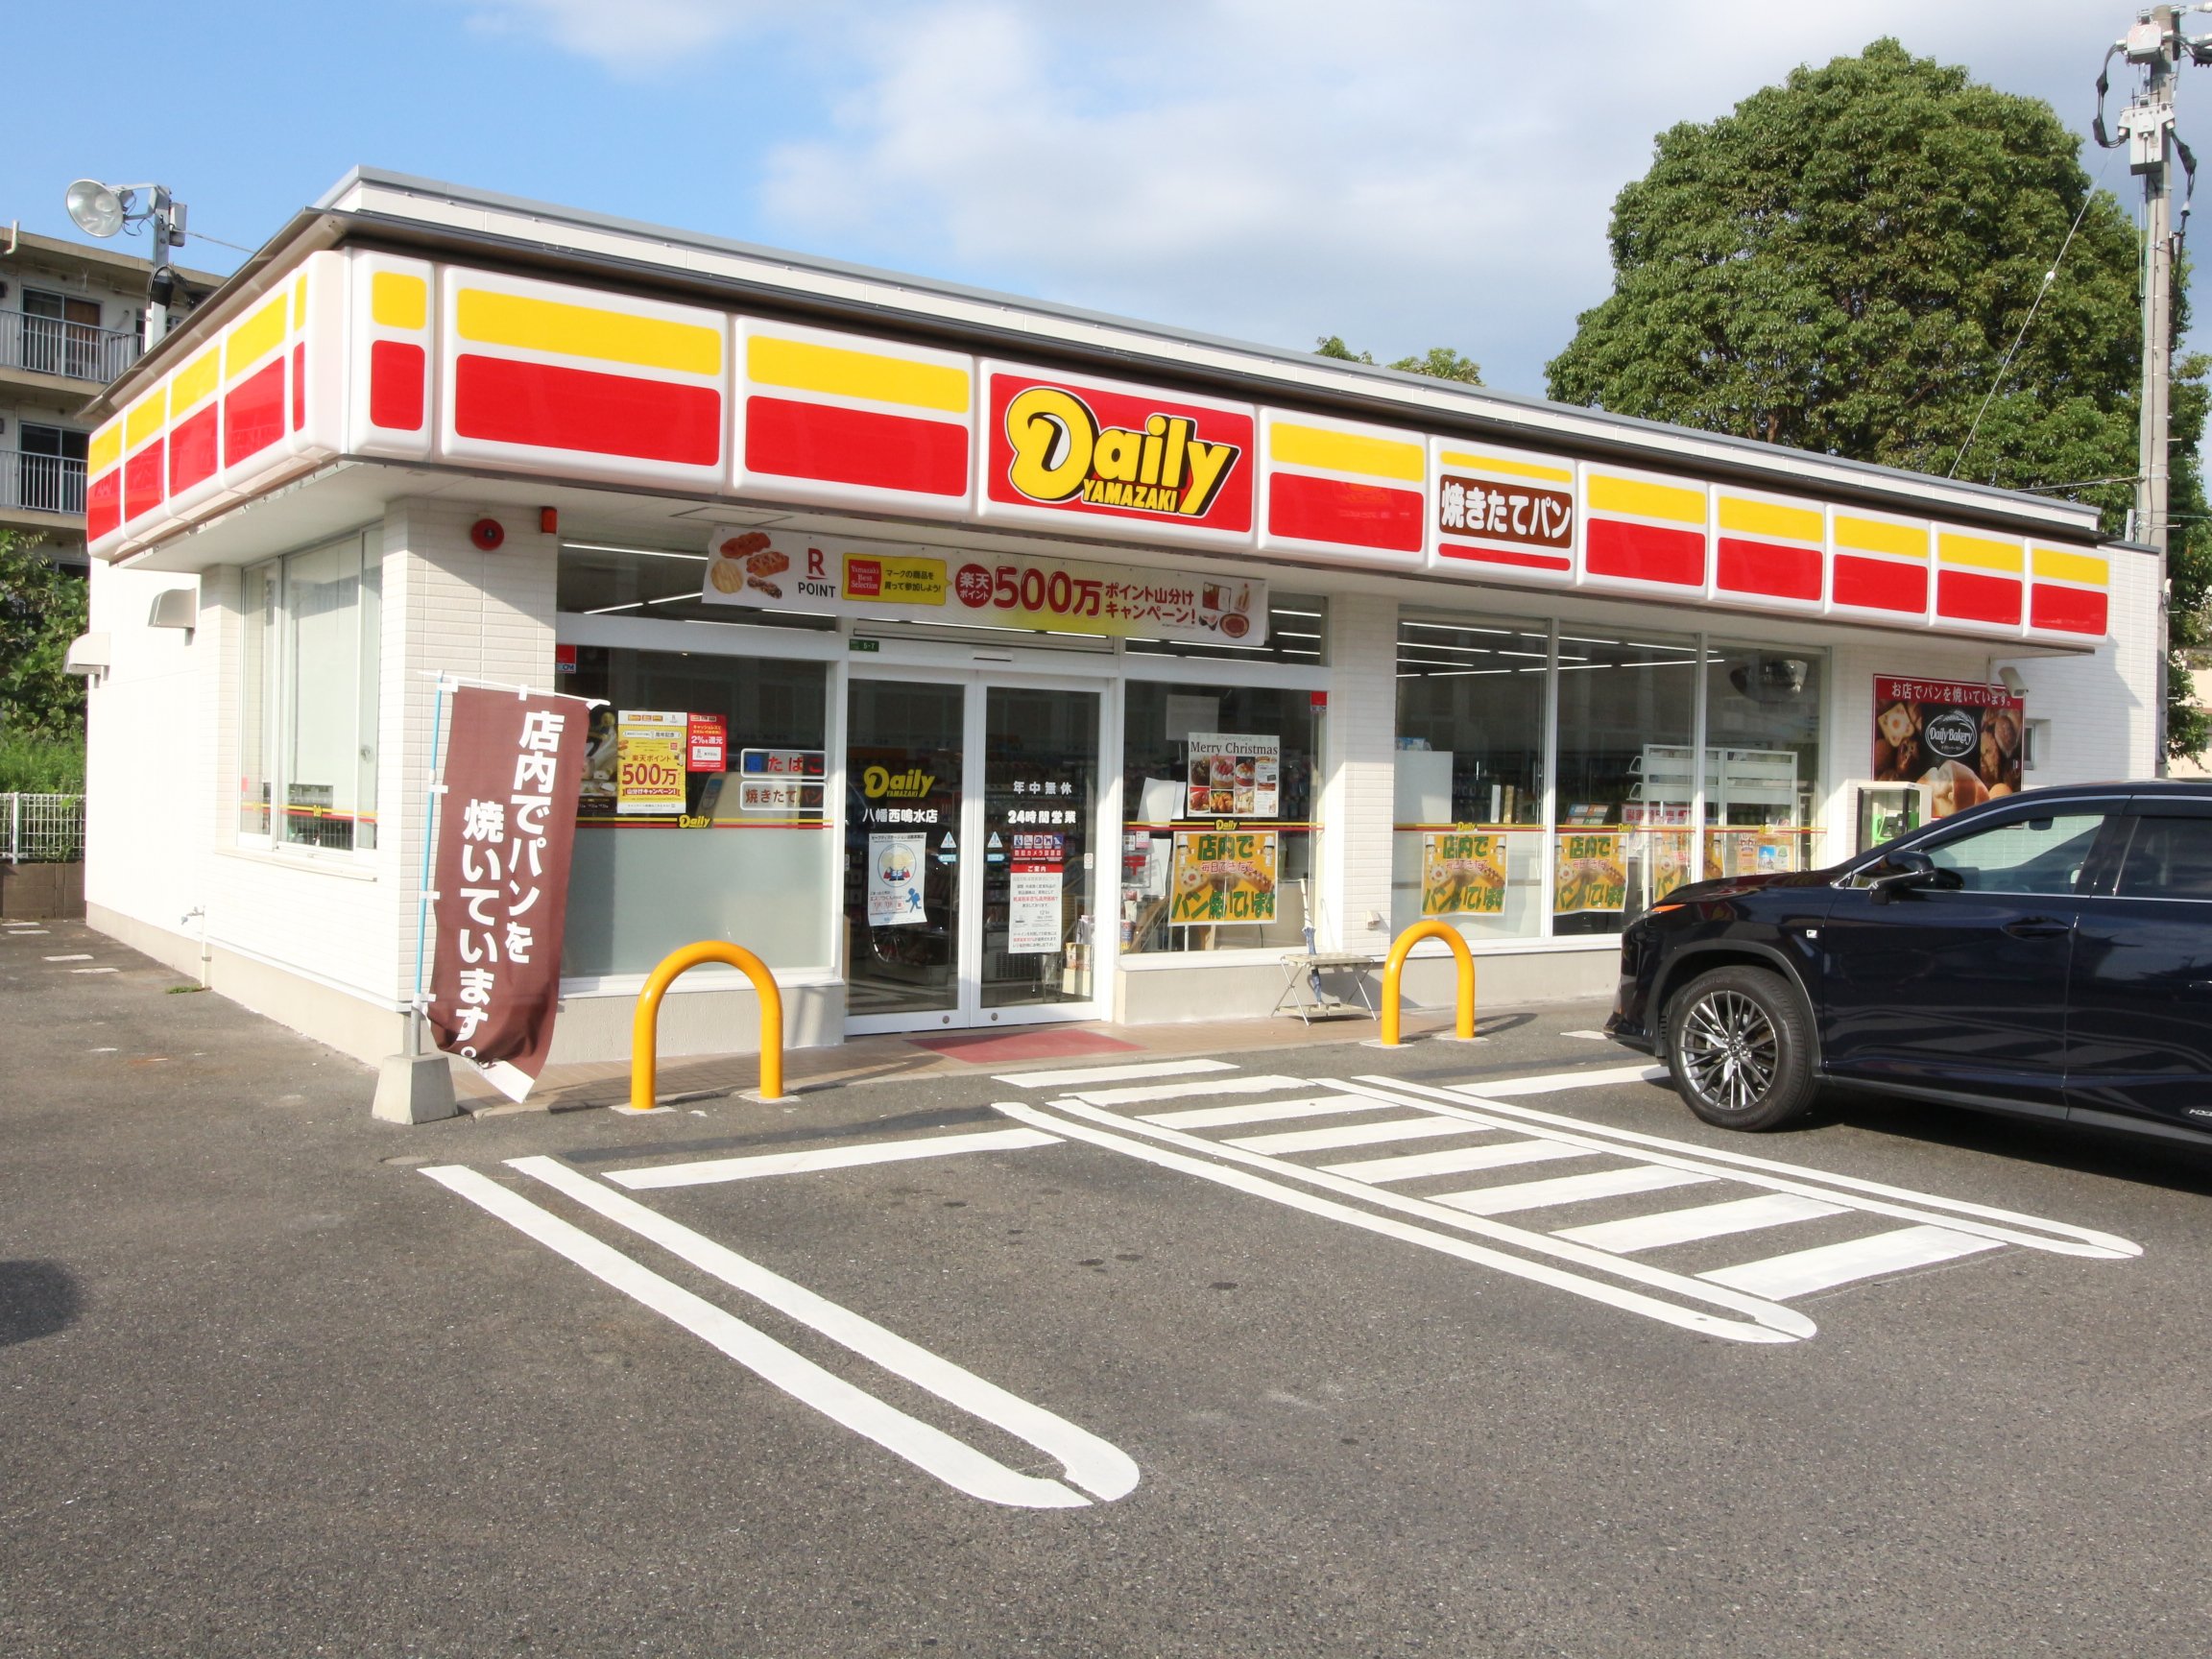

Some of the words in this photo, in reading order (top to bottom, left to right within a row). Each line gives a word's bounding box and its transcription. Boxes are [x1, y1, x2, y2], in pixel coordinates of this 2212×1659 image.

[1007, 388, 1240, 516] Daily
[1083, 478, 1178, 513] YAMAZAKI
[1441, 481, 1571, 539] 焼きたてパン
[807, 547, 826, 577] R
[851, 565, 879, 575] Yamazaki
[886, 569, 934, 580] マークの商品を
[960, 572, 990, 589] 楽天
[798, 582, 836, 598] POINT
[851, 581, 878, 590] Selection
[960, 589, 989, 600] ポイント
[993, 565, 1103, 616] 500万
[1105, 582, 1194, 606] ポイント山分け
[1105, 601, 1196, 624] キャンペーン!
[1930, 727, 1949, 744] Daily
[1948, 729, 1973, 746] Bakery
[1190, 741, 1221, 755] Merry
[1225, 742, 1278, 755] Christmas
[632, 754, 671, 762] 楽天ポイント
[621, 763, 678, 785] 500万
[864, 765, 936, 798] Daily
[745, 788, 823, 804] 焼きたてパン
[886, 789, 918, 798] YAMAZAKI
[1013, 781, 1072, 795] 年中無休
[679, 814, 711, 829] Daily
[862, 807, 938, 823] 八幡西鳴水店
[1007, 809, 1076, 824] 24時間営業
[1215, 819, 1238, 830] Daily
[505, 710, 565, 964] 店内でパンを
[1197, 833, 1255, 860] 店内で
[1443, 834, 1489, 859] 店内で
[1570, 835, 1612, 859] 店内で
[455, 799, 505, 1058] 焼いています。
